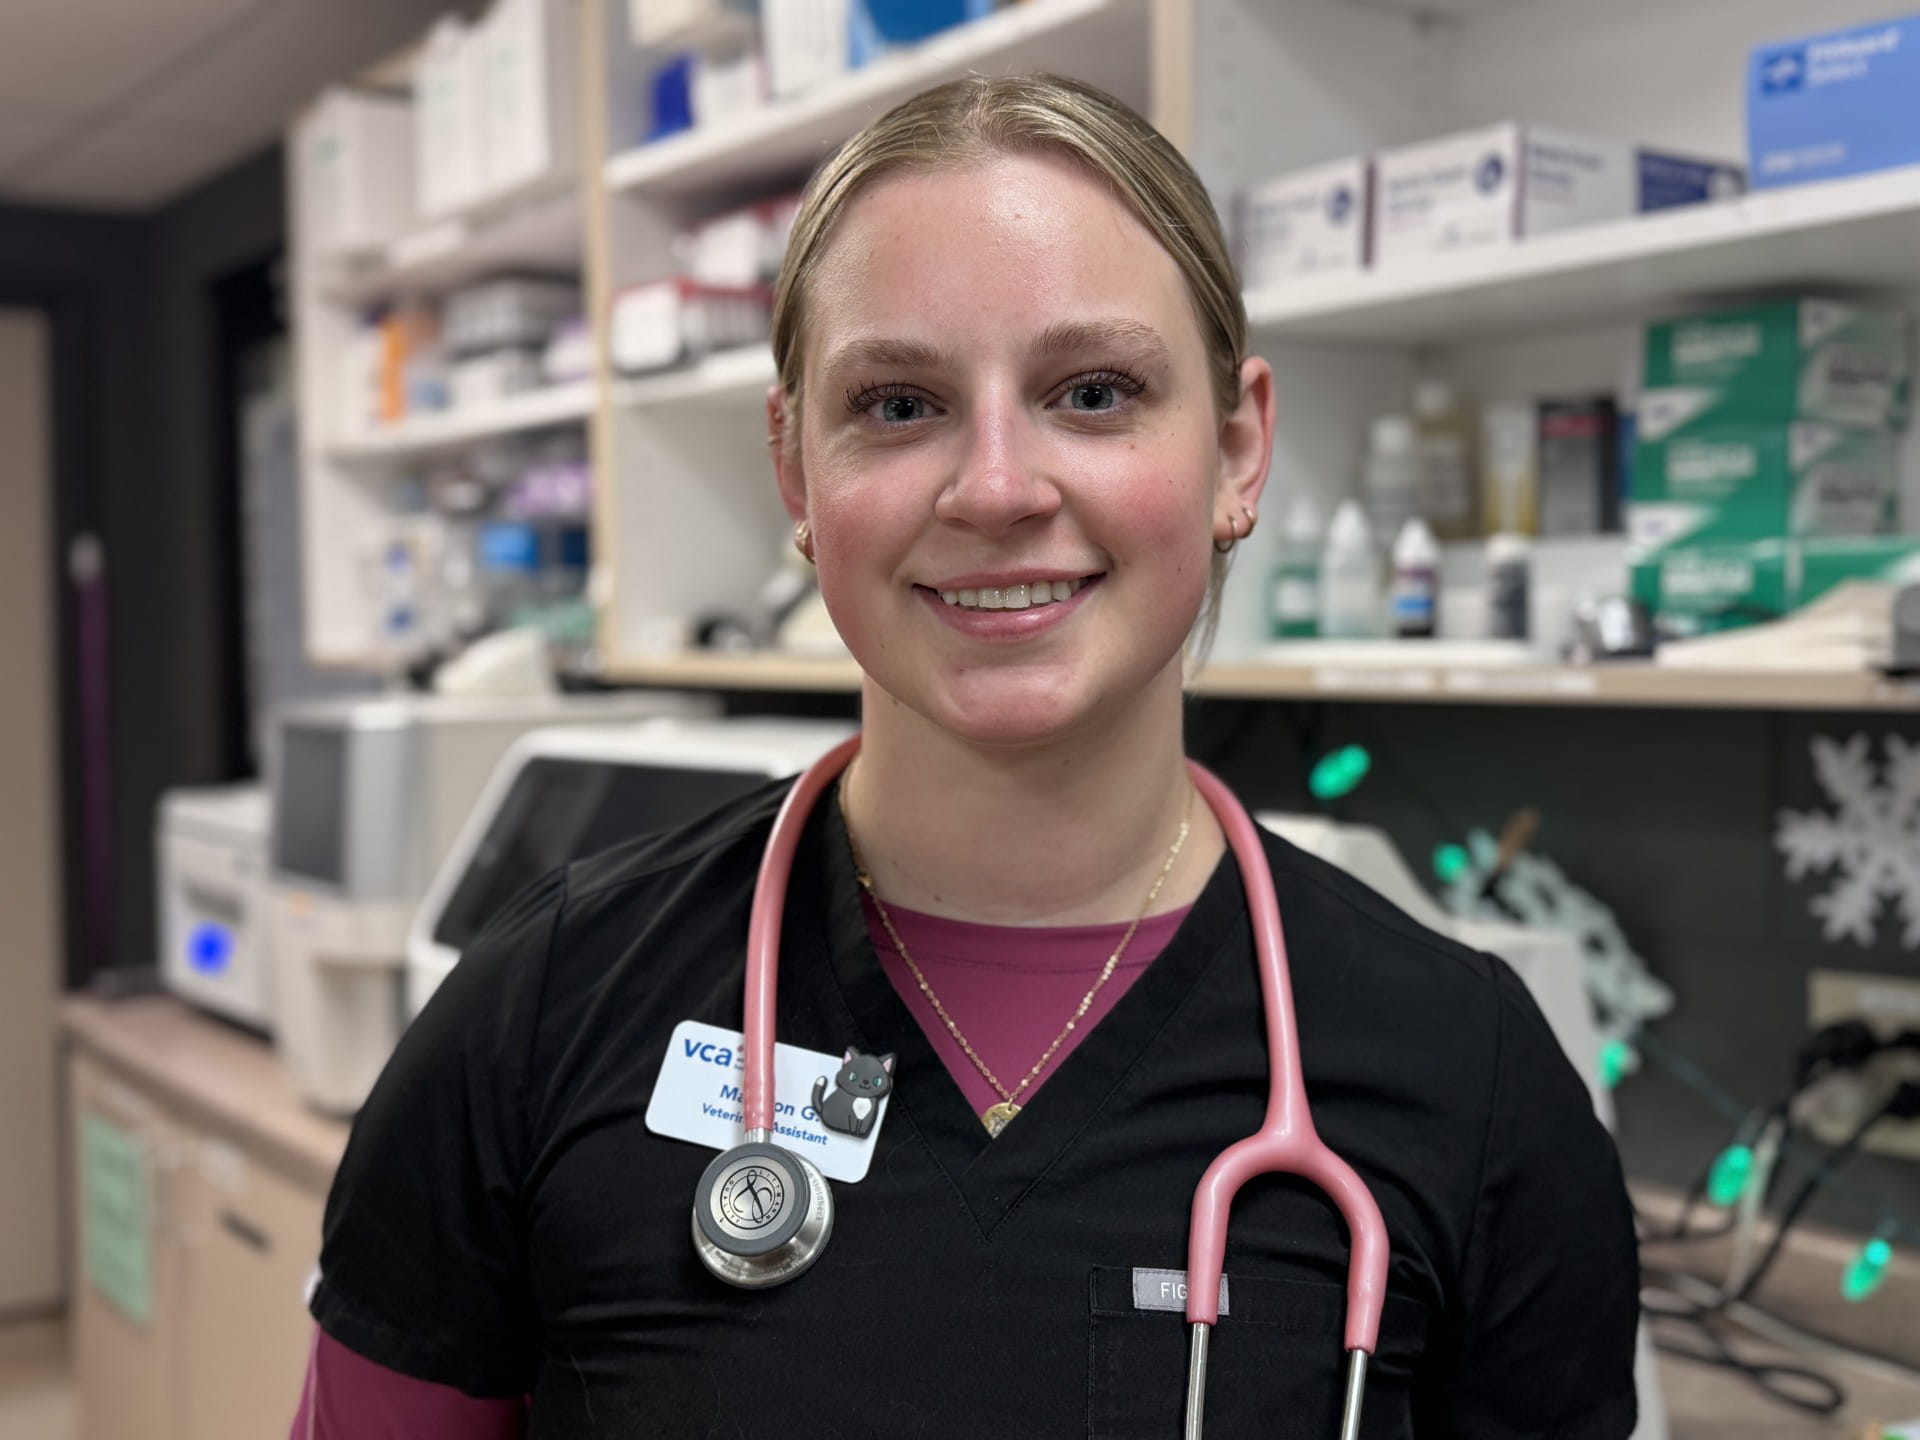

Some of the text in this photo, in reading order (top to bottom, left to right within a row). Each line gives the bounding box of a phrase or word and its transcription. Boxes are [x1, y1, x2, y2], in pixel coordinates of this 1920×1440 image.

[684, 1038, 733, 1068] vca
[720, 1084, 820, 1122] Maon G.
[772, 1121, 828, 1145] Assistant
[1160, 1282, 1191, 1300] FIG
